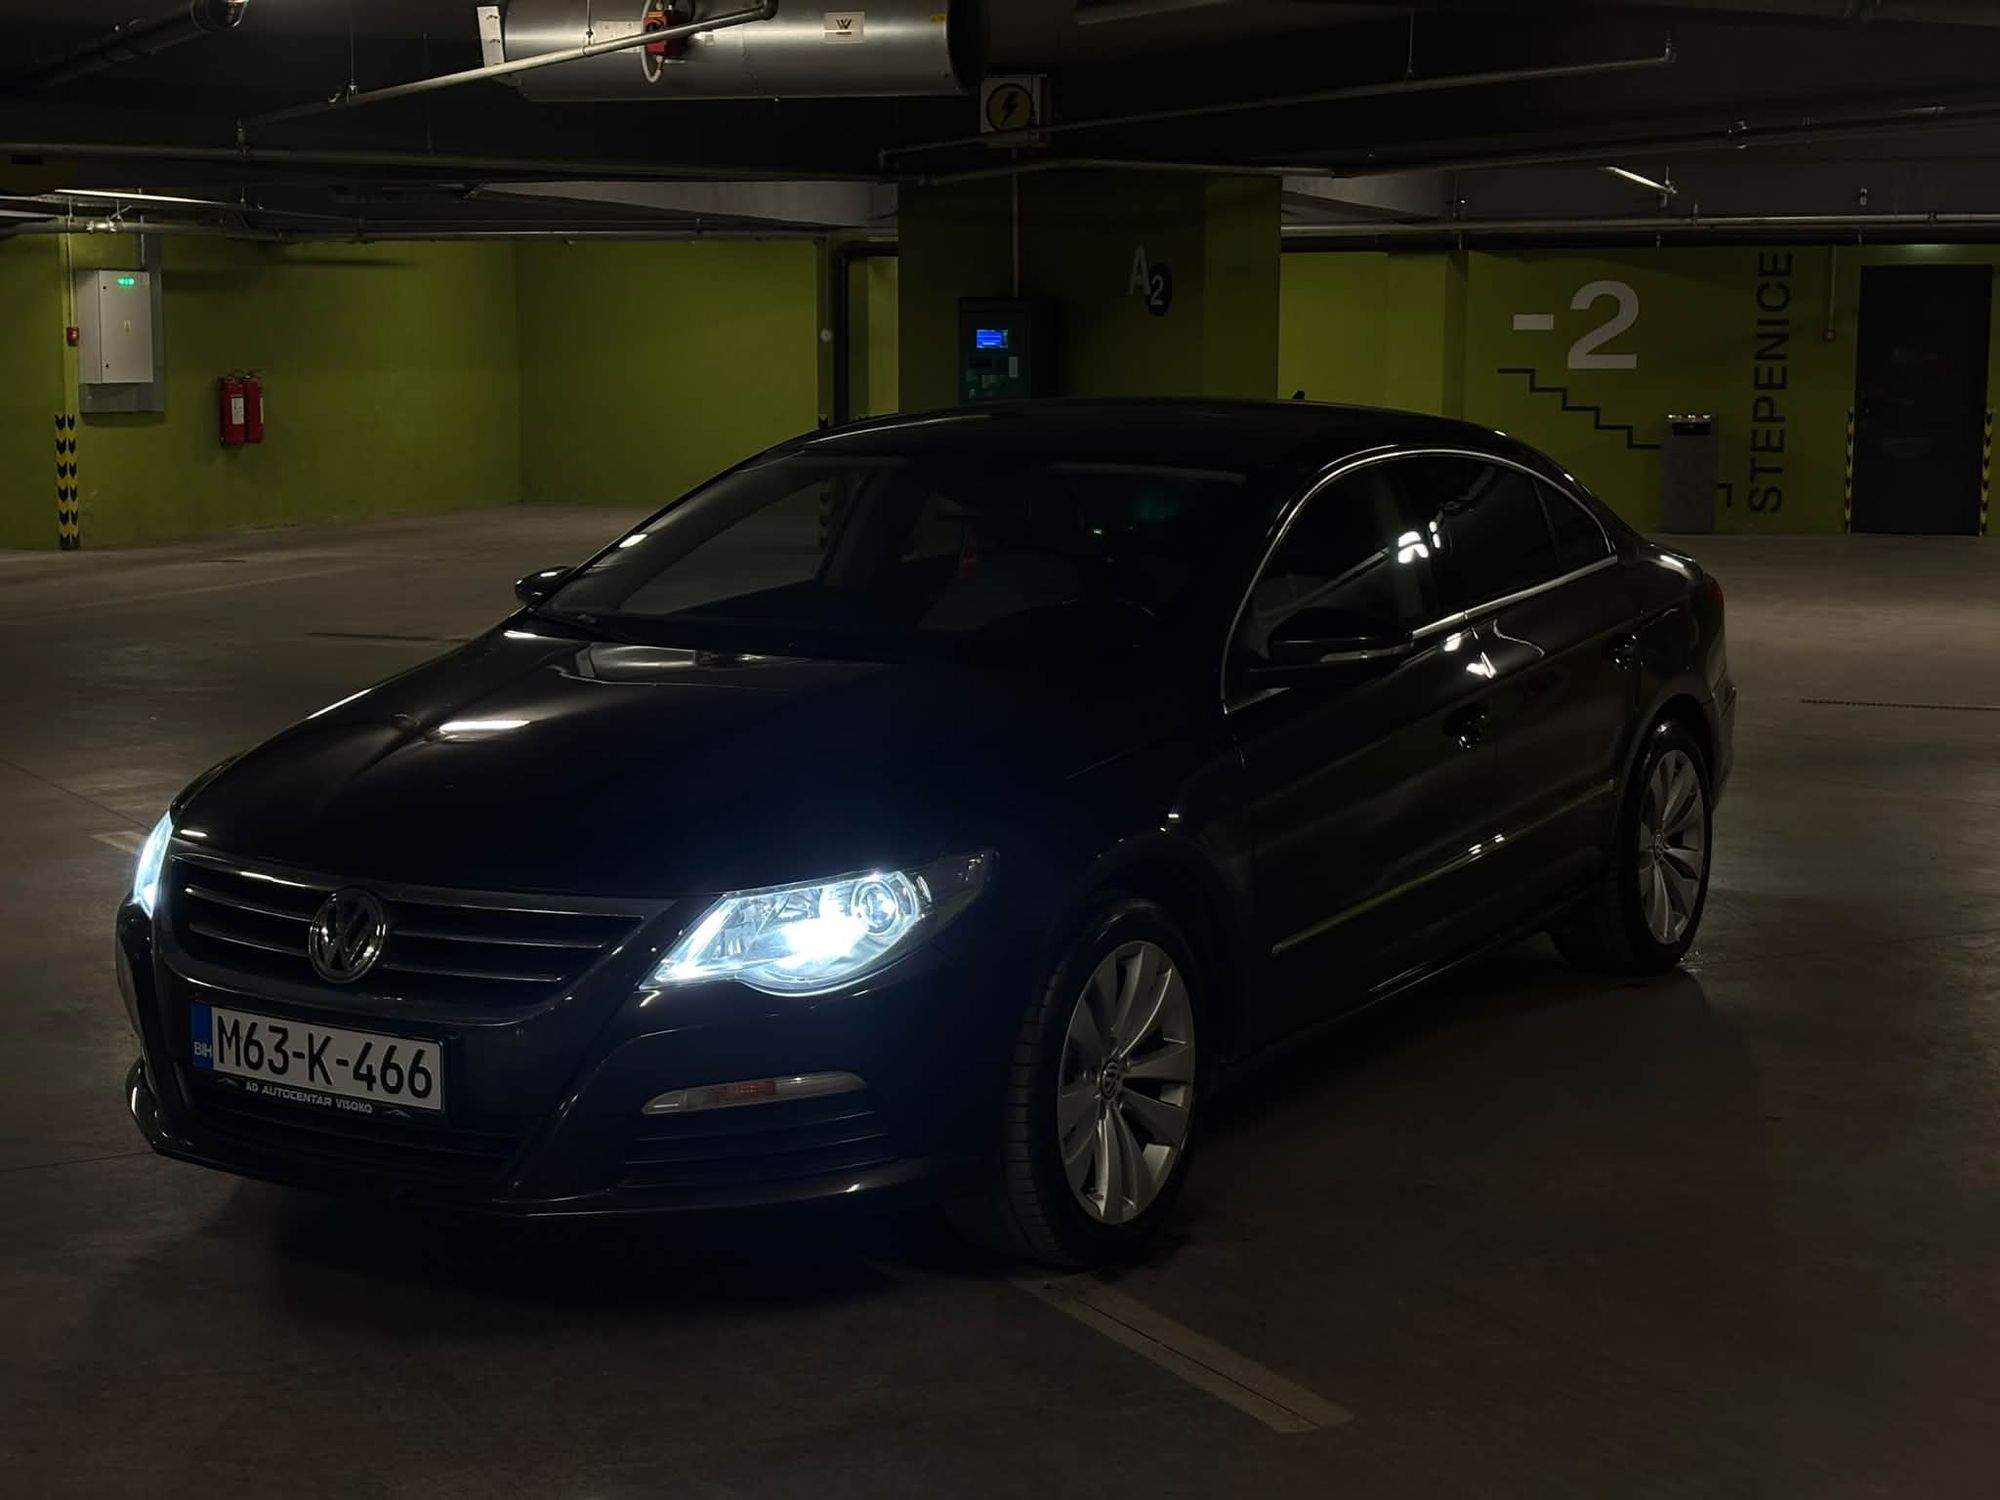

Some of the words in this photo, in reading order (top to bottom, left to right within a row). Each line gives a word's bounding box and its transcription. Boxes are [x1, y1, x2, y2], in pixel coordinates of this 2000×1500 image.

[1512, 280, 1639, 369] -2
[1748, 251, 1793, 512] STEPENICE
[216, 1015, 433, 1099] M63-K-466
[261, 1086, 332, 1108] AUTOCENTAR
[335, 1099, 373, 1114] VISOKO
